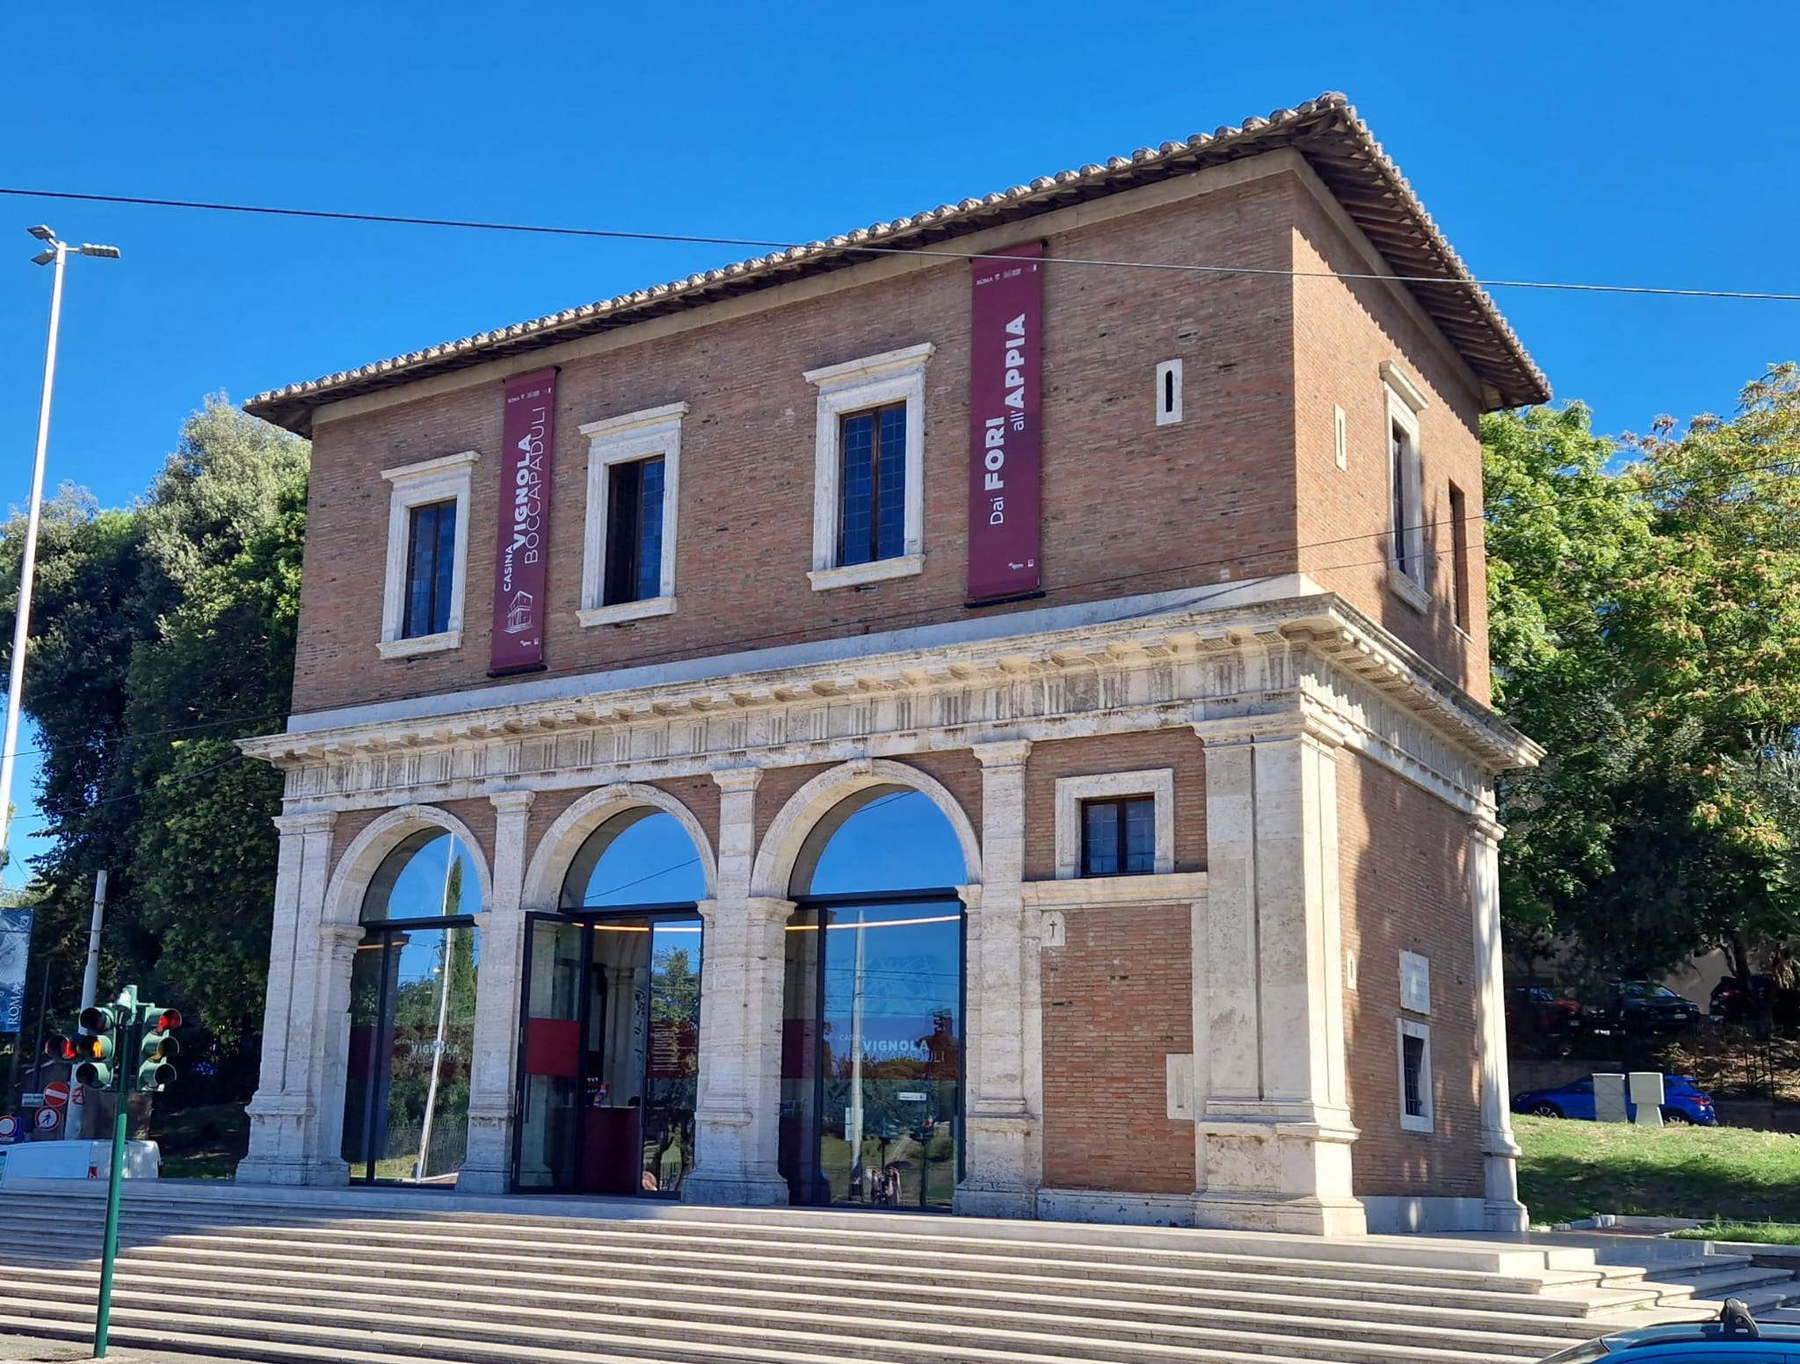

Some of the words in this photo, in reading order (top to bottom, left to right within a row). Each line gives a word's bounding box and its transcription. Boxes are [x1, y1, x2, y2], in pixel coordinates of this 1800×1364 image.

[984, 416, 1005, 491] FORI
[513, 433, 531, 550] VIGNOLA
[524, 406, 545, 564] BOCCAPADULI
[990, 496, 1004, 525] Dai
[503, 544, 513, 592] CASINA
[862, 1040, 929, 1051] VIGNOLA
